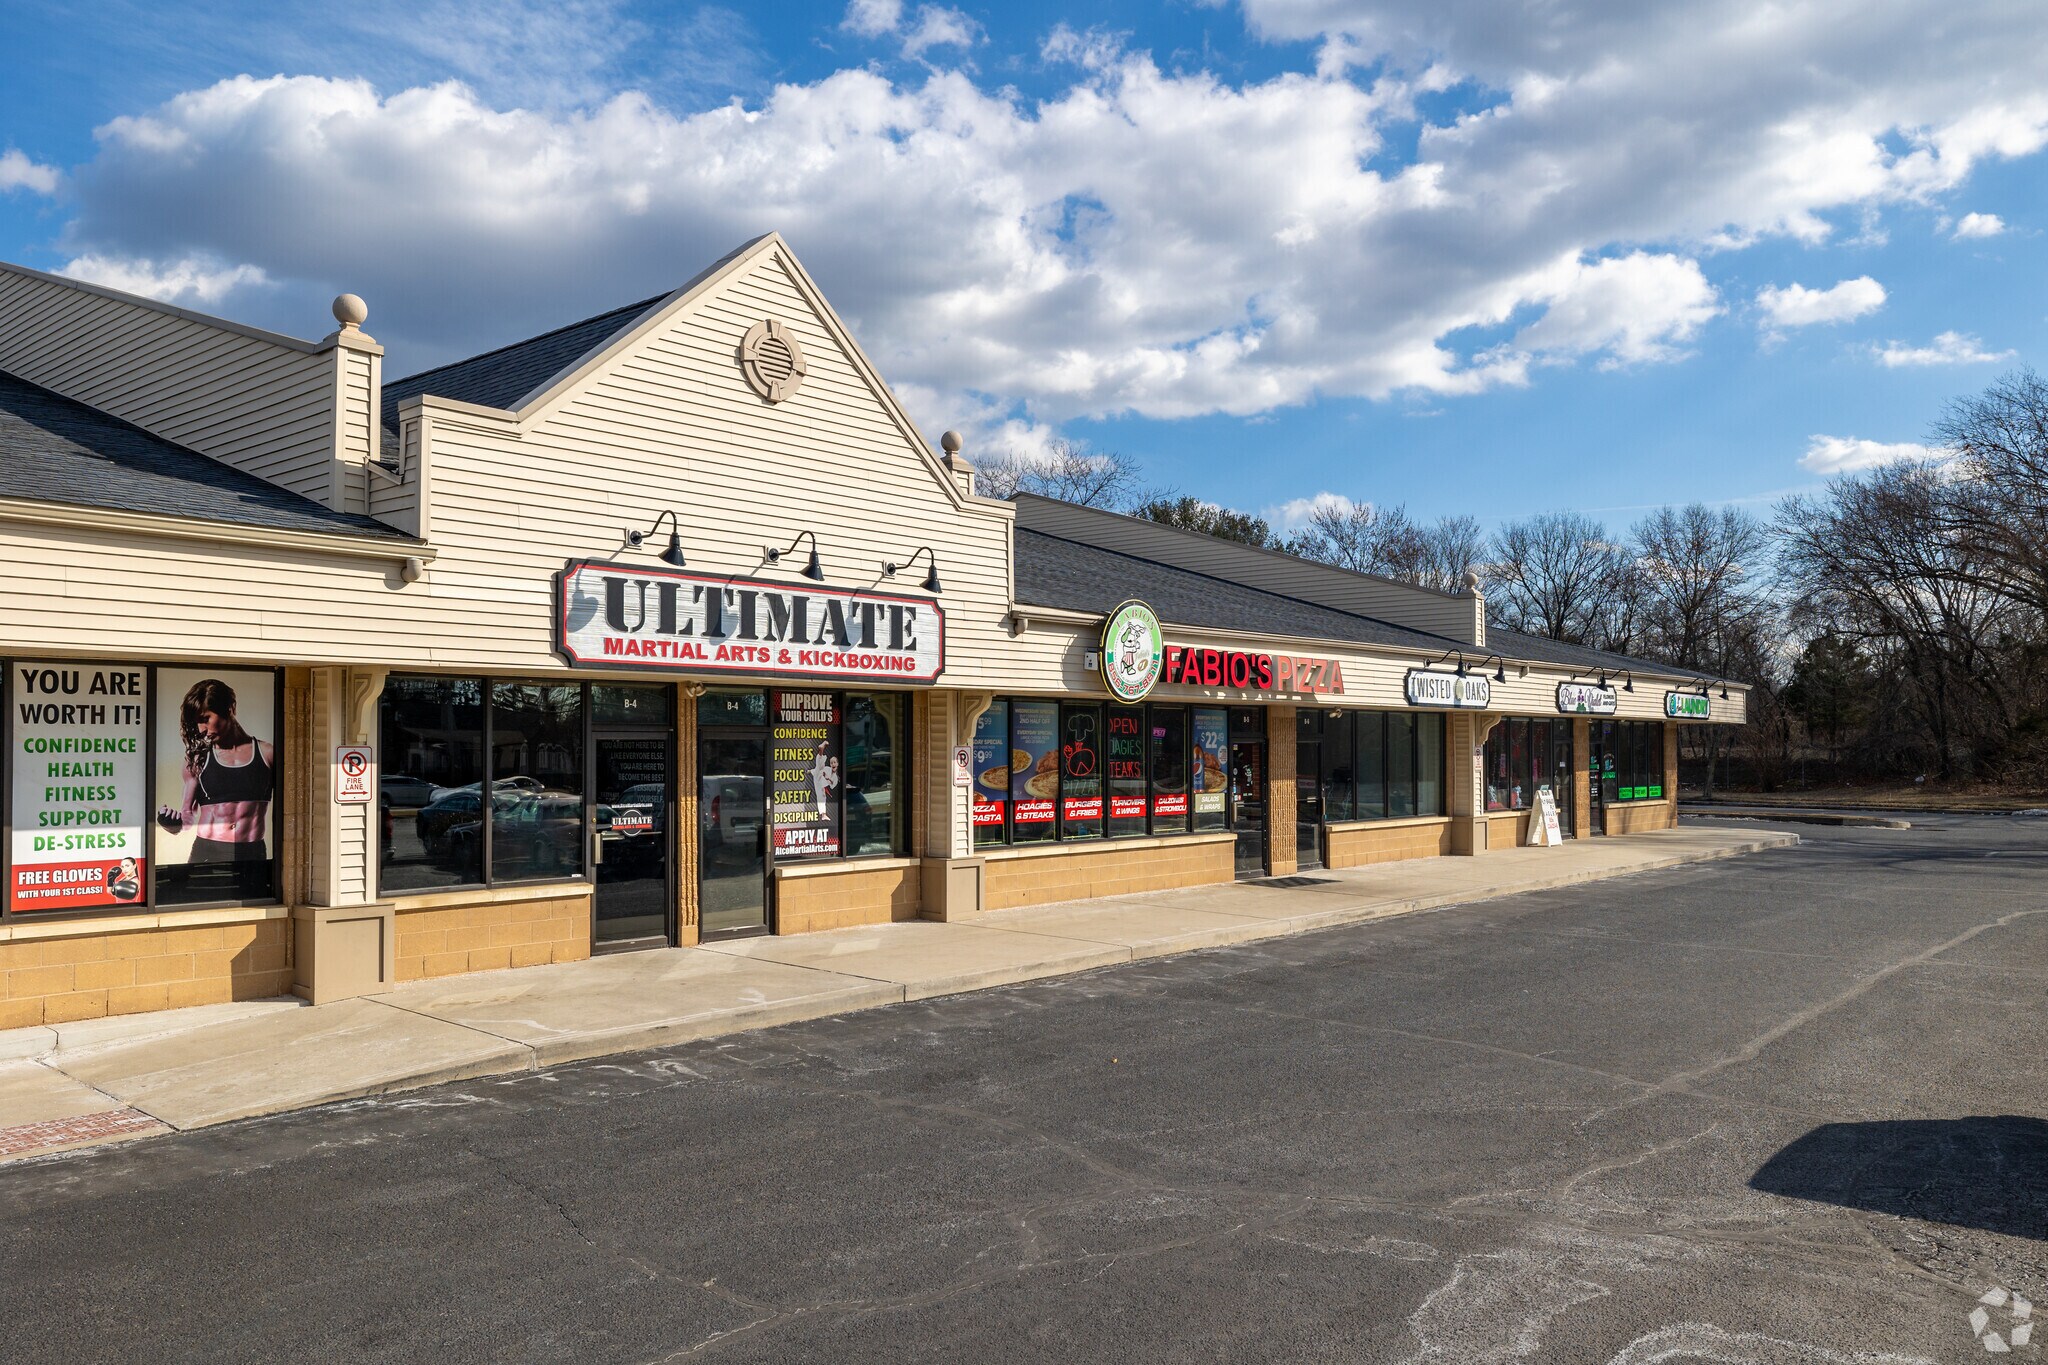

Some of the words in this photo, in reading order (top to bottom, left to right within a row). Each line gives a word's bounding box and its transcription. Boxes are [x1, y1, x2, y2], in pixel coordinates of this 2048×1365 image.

[602, 577, 916, 652] ULTIMATE
[604, 637, 709, 660] MARTIAL
[715, 643, 770, 663] ARTS
[776, 649, 792, 664] &
[800, 650, 916, 671] KICKBOXING
[1165, 645, 1273, 690] FABIO'S
[1277, 656, 1344, 694] PIZZA
[20, 669, 79, 694] YOU
[89, 672, 141, 695] ARE
[1411, 677, 1451, 699] TWISTED
[1465, 681, 1487, 701] OAKS
[624, 699, 638, 708] B-4
[727, 701, 739, 711] B-4
[781, 693, 833, 710] IMPROVE
[1681, 697, 1708, 715] LAUNDRY
[20, 704, 105, 724] WORTH
[114, 705, 141, 725] IT!
[781, 710, 802, 722] YOUR
[803, 711, 833, 722] CHILD'S
[773, 728, 828, 739] CONFIDENCE
[24, 738, 136, 753] CONFIDENCE
[1110, 738, 1142, 756] AGIES
[774, 748, 814, 761] FITNESS
[48, 762, 114, 777] HEALTH
[774, 769, 805, 782] FOCUS
[1109, 761, 1141, 778] TEAKS
[45, 785, 116, 802] FITNESS
[774, 790, 811, 804] SAFETY
[973, 804, 996, 812] PIZZA
[1017, 802, 1053, 810] HOAGIES
[1065, 800, 1102, 808] BURGERS
[1112, 798, 1146, 806] TURNOVERS
[38, 809, 122, 827] SUPPORT
[774, 811, 819, 823] DISCIPLINE
[973, 814, 1002, 822] PASTA
[1022, 811, 1055, 819] STEAKS
[1076, 809, 1098, 817] FRIES
[612, 816, 652, 825] ULTIMATE
[34, 832, 126, 851] DE-STRESS
[785, 829, 815, 845] APPLY
[816, 828, 829, 843] AT
[18, 871, 50, 885] FREE
[52, 868, 103, 883] GLOVES
[17, 889, 39, 899] WITH
[40, 888, 61, 897] YOUR
[62, 886, 75, 896] 1ST
[76, 886, 103, 895] CLASS!
